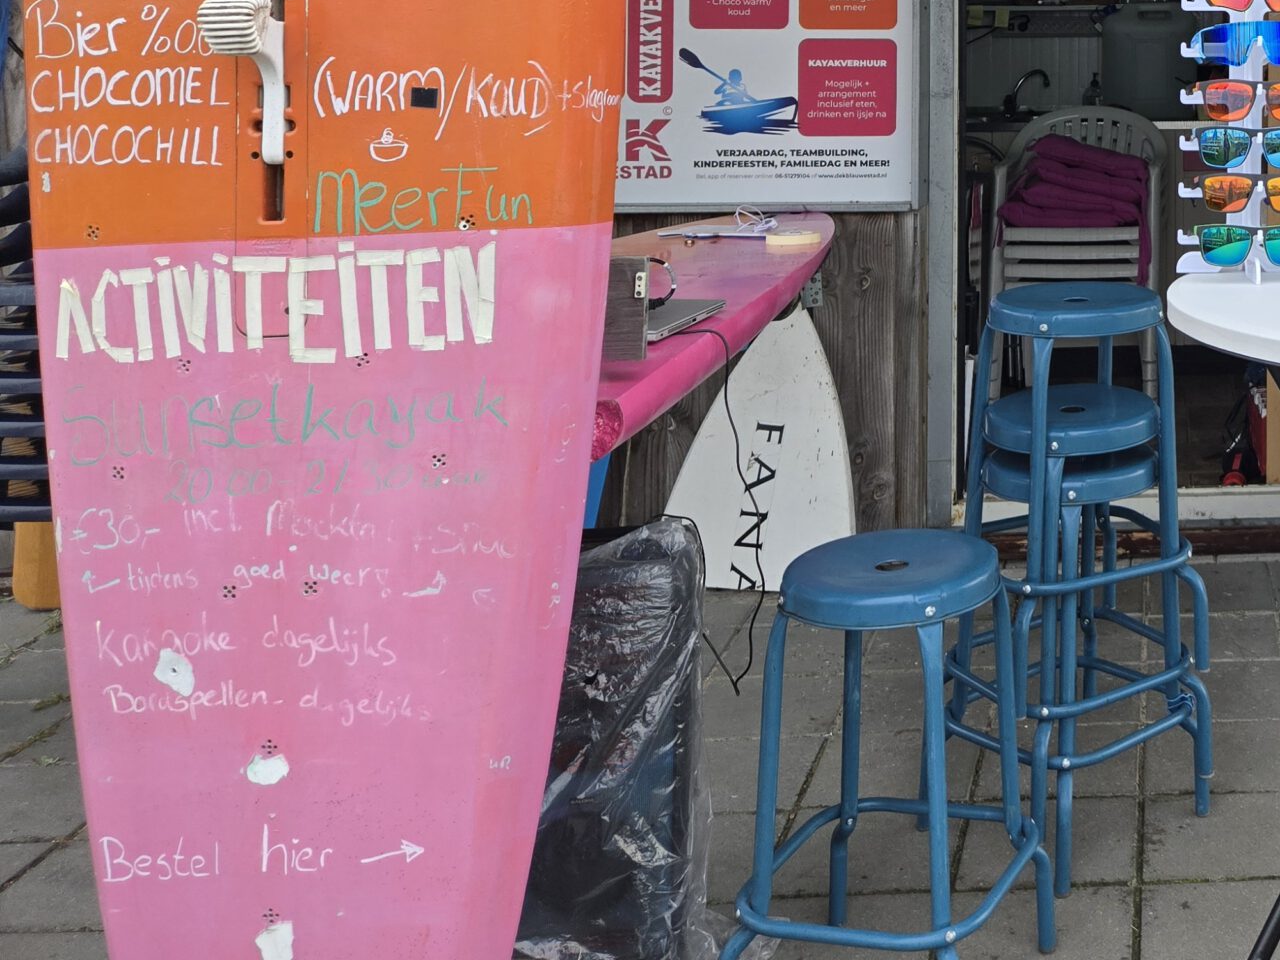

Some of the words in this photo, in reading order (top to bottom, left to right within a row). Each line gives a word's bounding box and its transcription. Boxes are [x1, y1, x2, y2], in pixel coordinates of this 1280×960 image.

[727, 7, 751, 16] koud
[808, 59, 887, 68] KAYAKVERHUUR
[825, 79, 863, 89] Mogelijk
[31, 66, 230, 113] CHOCOMEL
[817, 90, 877, 99] arrangement
[817, 100, 854, 108] inclusief
[807, 110, 842, 118] drinken
[34, 124, 222, 166] CHOCOCHILL
[716, 149, 787, 159] VERJAARDAG,
[789, 149, 868, 159] TEAMBUILDING,
[693, 160, 778, 170] KINDERFEESTEN,
[780, 160, 841, 168] FAMILIEDAG
[844, 160, 857, 168] EN
[859, 159, 890, 168] MEER!
[101, 836, 220, 883] Bestel
[261, 823, 334, 876] hier
